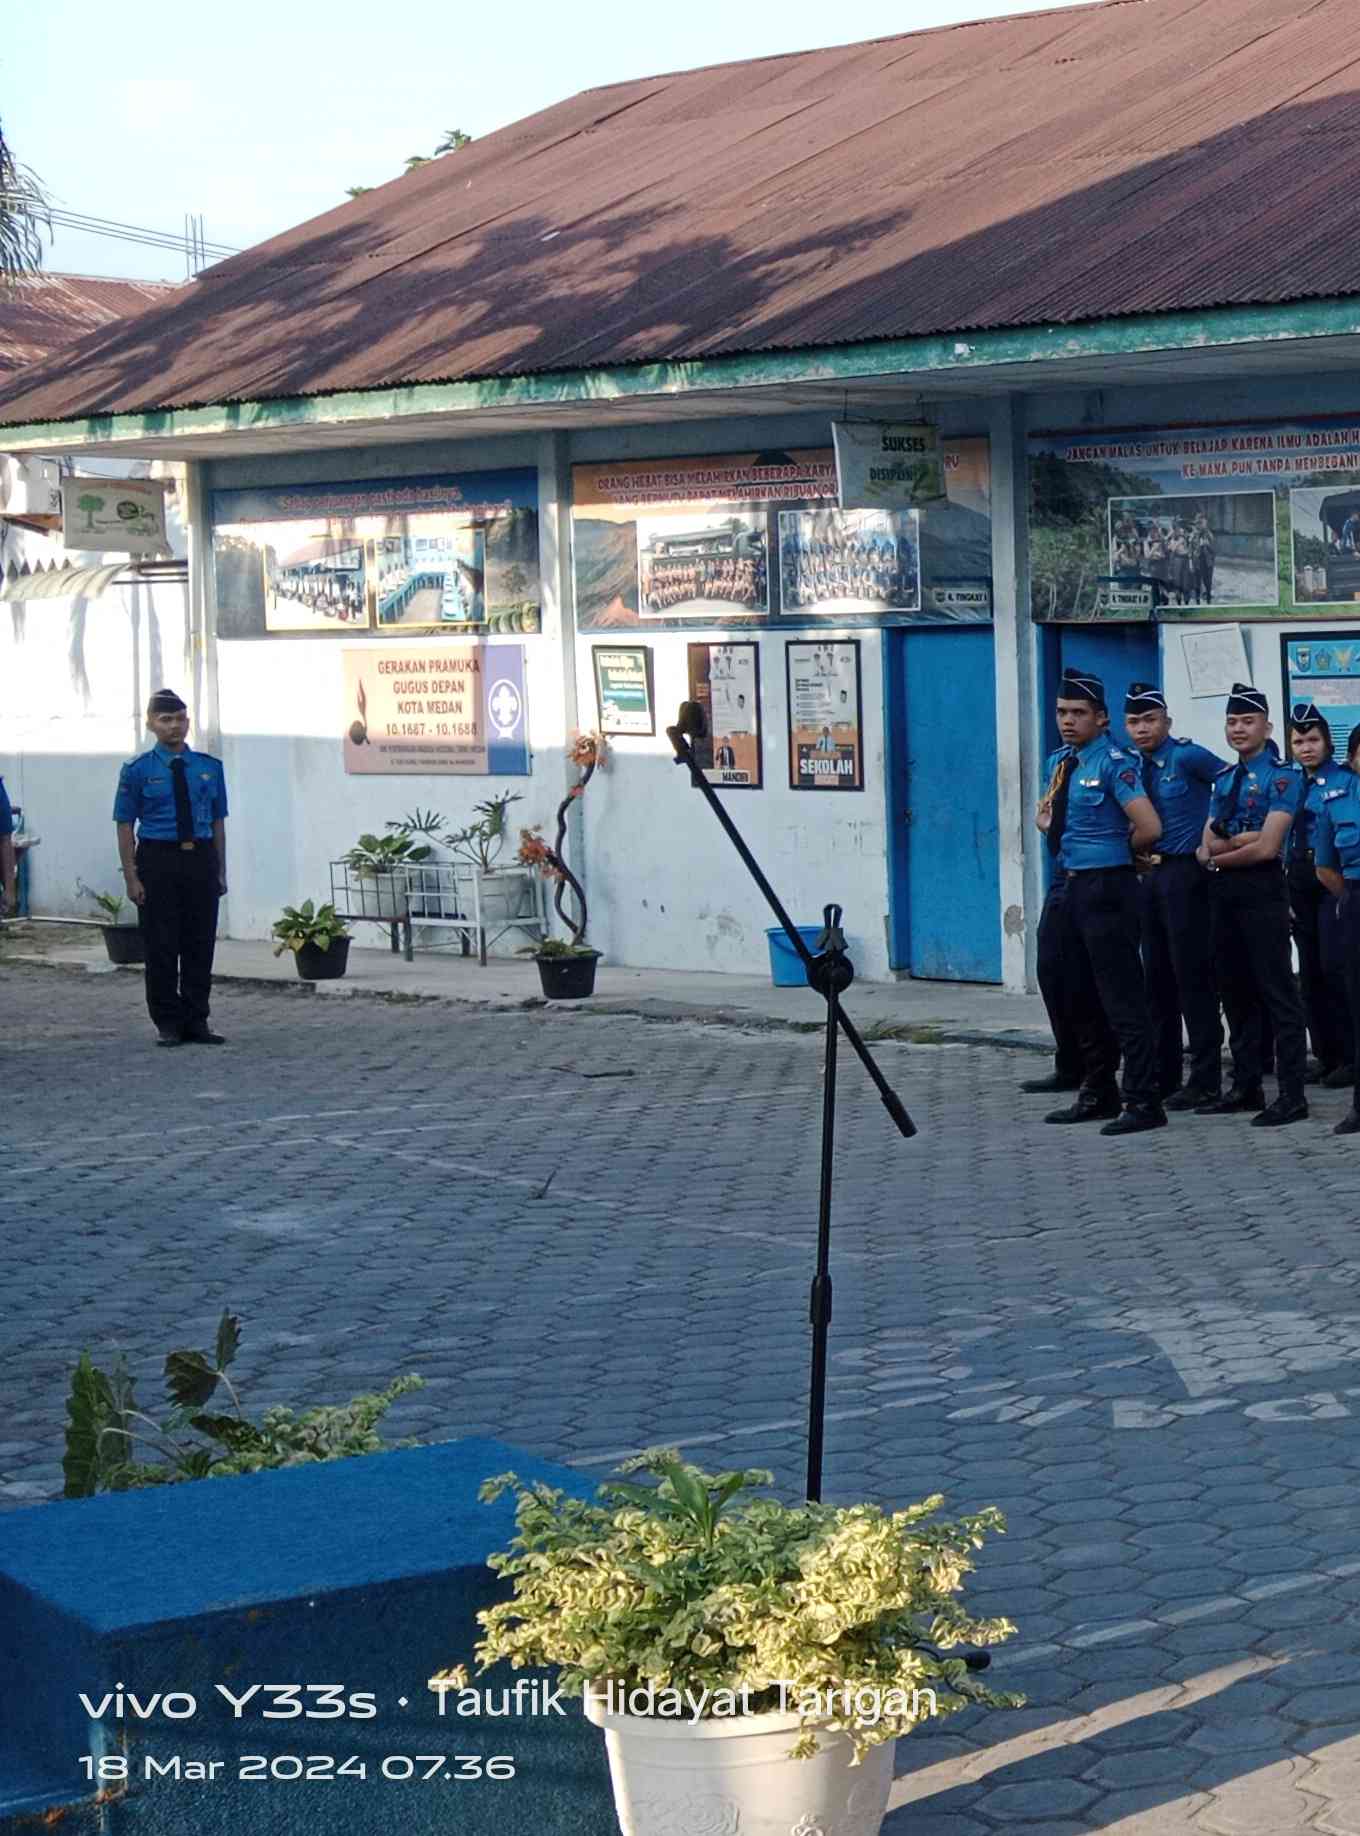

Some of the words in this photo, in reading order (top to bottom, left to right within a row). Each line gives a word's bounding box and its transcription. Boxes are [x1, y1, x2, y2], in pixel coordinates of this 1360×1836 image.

[882, 436, 925, 451] SUKSES
[1109, 444, 1141, 459] MALAS
[1146, 442, 1179, 457] UNTUK
[1183, 440, 1228, 455] BELAJAR
[1232, 437, 1273, 451] KARENA
[1277, 434, 1300, 448] ILMU
[1305, 432, 1348, 447] ADALAH
[1231, 462, 1251, 476] PUN
[1256, 458, 1290, 473] TANPA
[598, 475, 629, 490] ORANG
[752, 466, 801, 481] BEBERAPA
[378, 660, 426, 674] GERAKAN
[429, 659, 480, 673] PRAMUKA
[393, 680, 428, 694] GUGUS
[431, 680, 464, 693] DEPAN
[398, 701, 424, 714] KOTA
[427, 700, 462, 714] MEDAN
[800, 759, 853, 775] SEKOLAH
